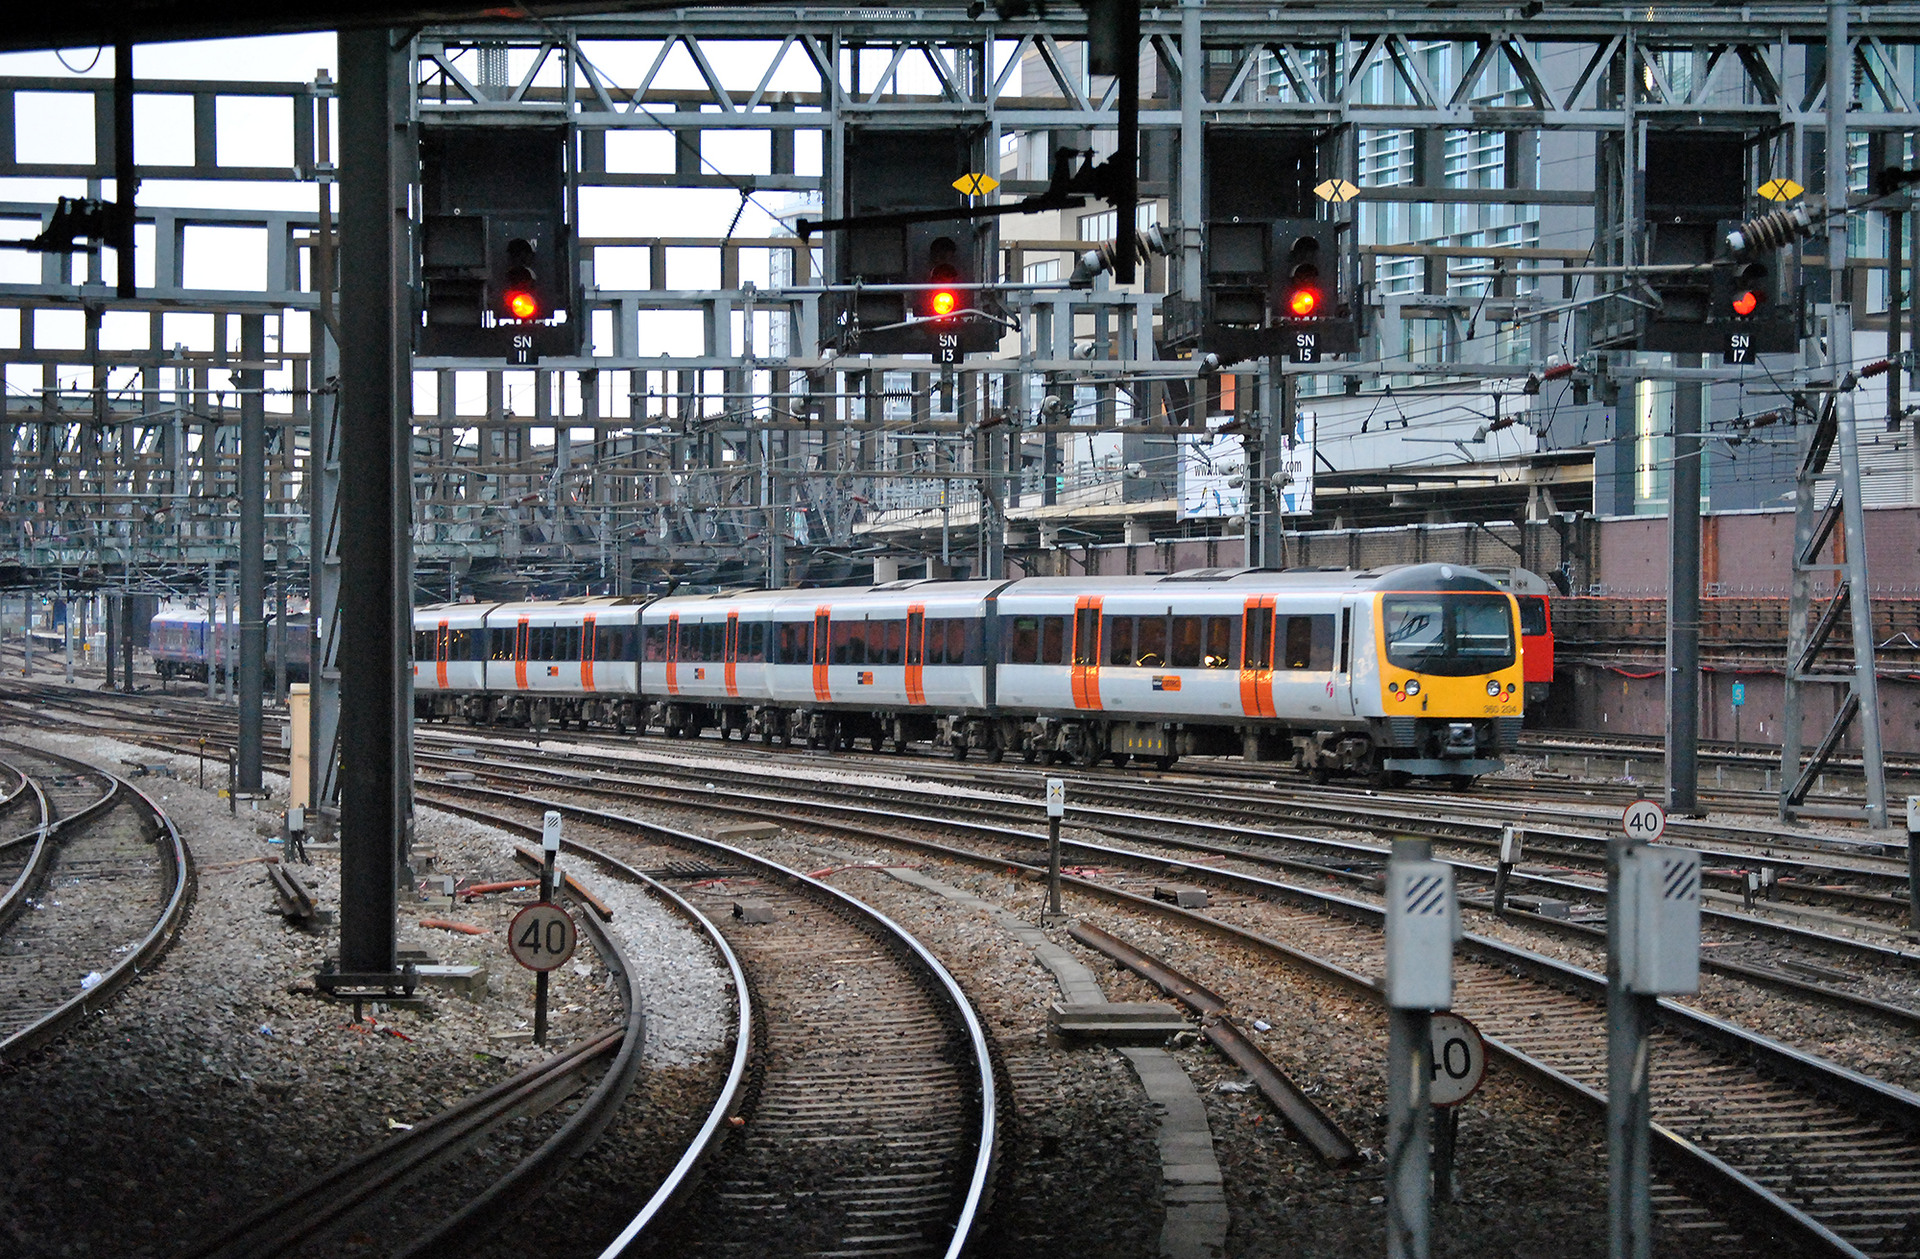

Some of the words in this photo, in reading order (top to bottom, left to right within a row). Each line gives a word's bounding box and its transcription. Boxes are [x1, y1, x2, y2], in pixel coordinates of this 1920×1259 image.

[513, 335, 532, 348] SN
[939, 333, 957, 347] SN
[1296, 334, 1315, 347] SN
[1731, 335, 1750, 348] SN
[518, 350, 527, 363] 11
[942, 349, 954, 362] 13
[1299, 348, 1312, 361] 15
[1733, 349, 1746, 363] 17
[1629, 812, 1658, 832] 40
[518, 918, 566, 955] 40
